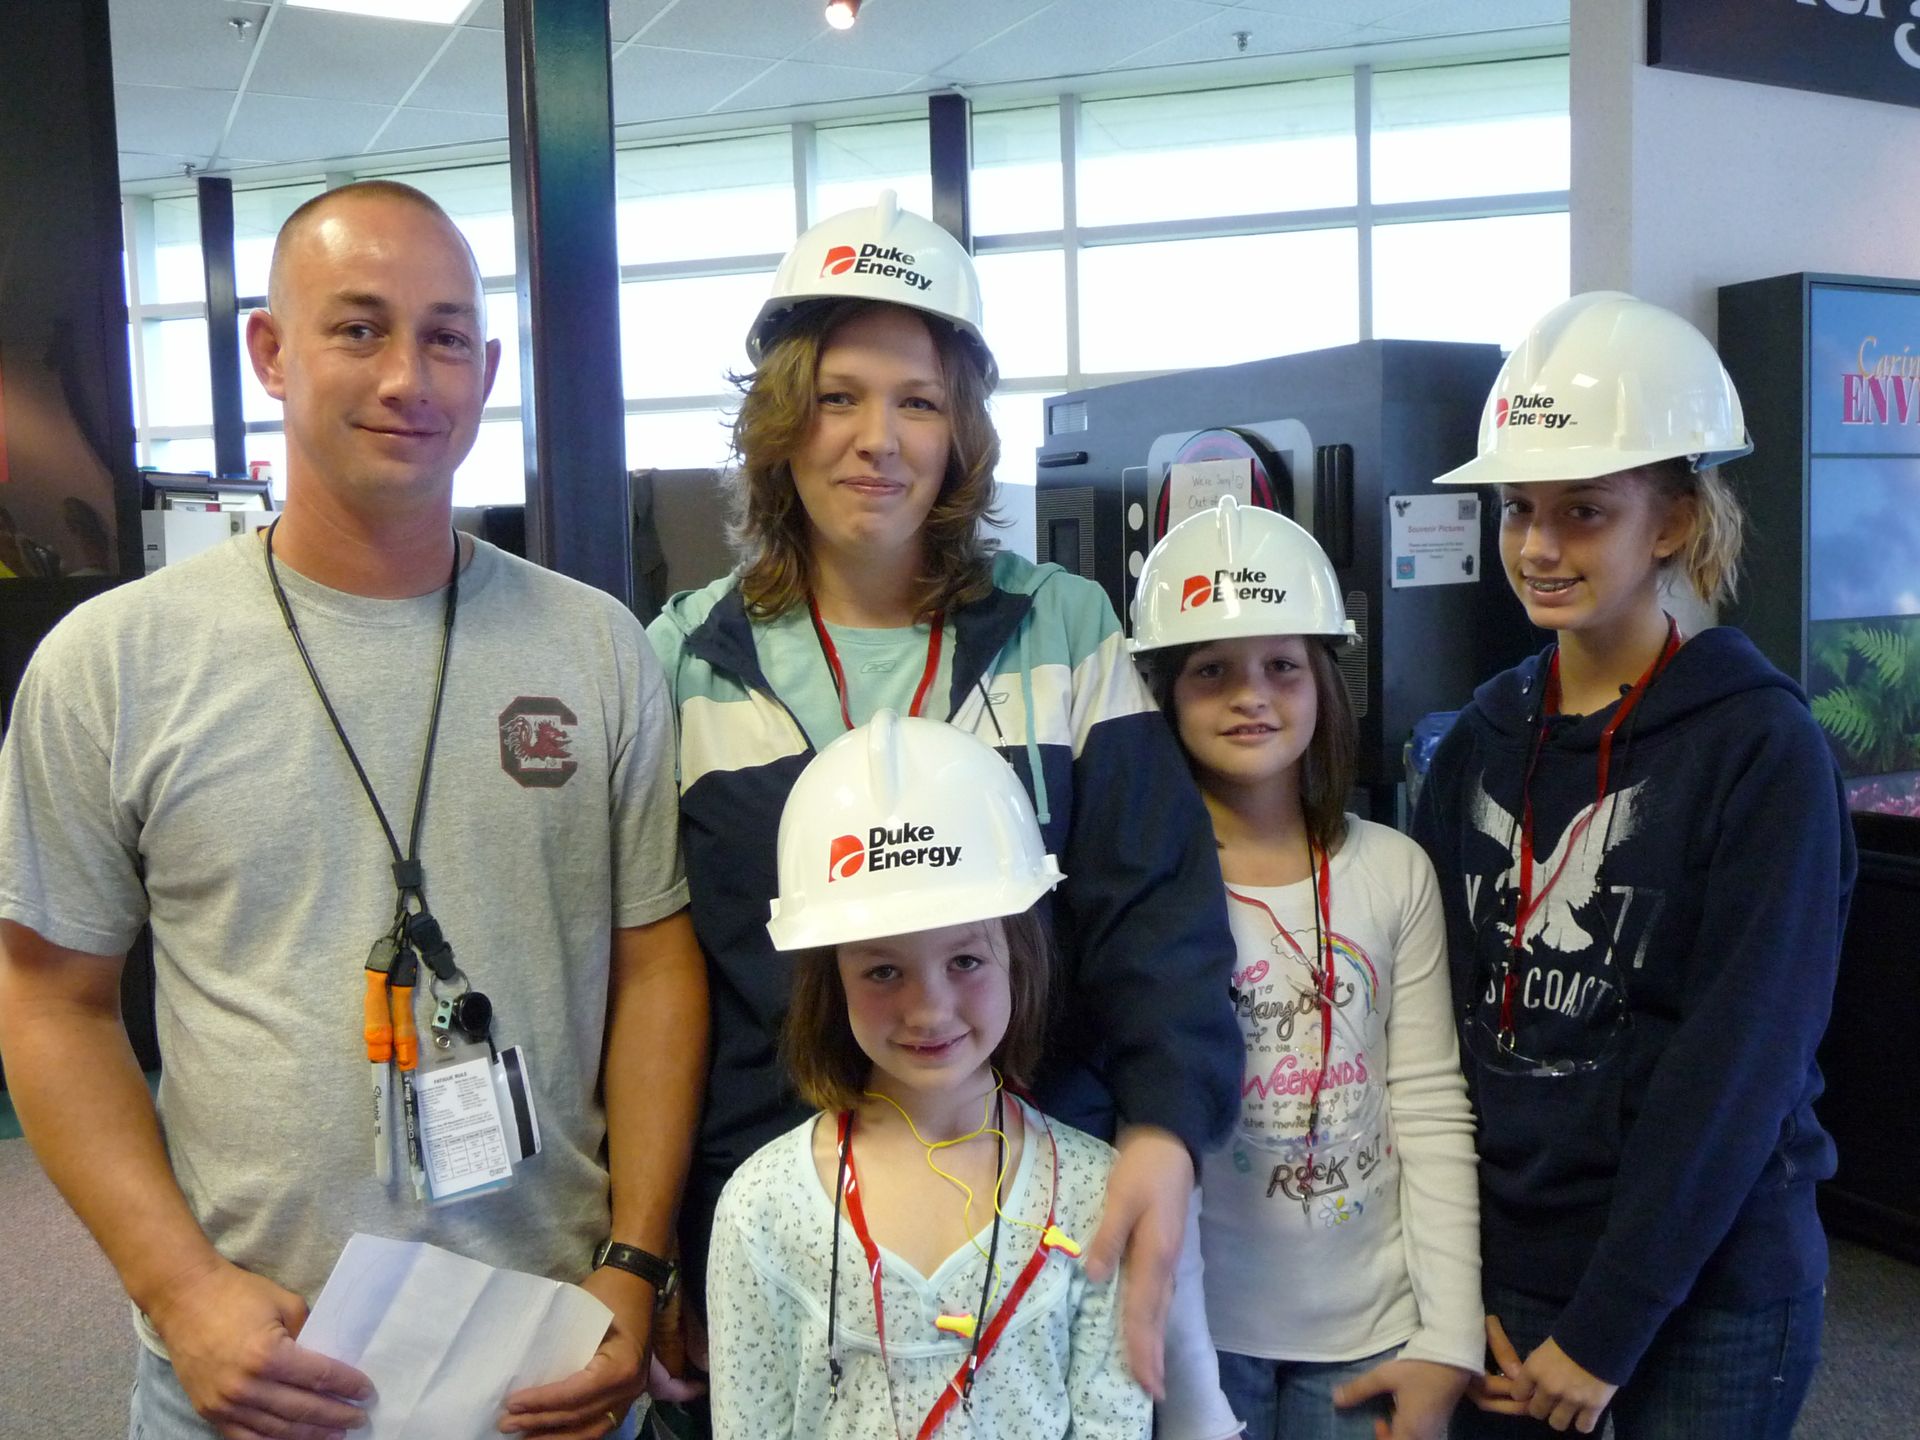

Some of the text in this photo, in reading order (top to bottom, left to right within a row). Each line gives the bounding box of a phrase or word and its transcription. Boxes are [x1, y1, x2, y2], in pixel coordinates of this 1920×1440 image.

[860, 244, 915, 265] Duke
[854, 258, 932, 290] Energy
[1512, 394, 1554, 409] Duke
[1842, 373, 1920, 424] ENV
[1509, 411, 1571, 428] Energy
[1214, 568, 1266, 585] Duke
[1213, 586, 1286, 604] Eergy
[869, 823, 935, 849] Duke
[869, 846, 962, 872] Energy
[1523, 967, 1613, 1023] COAST
